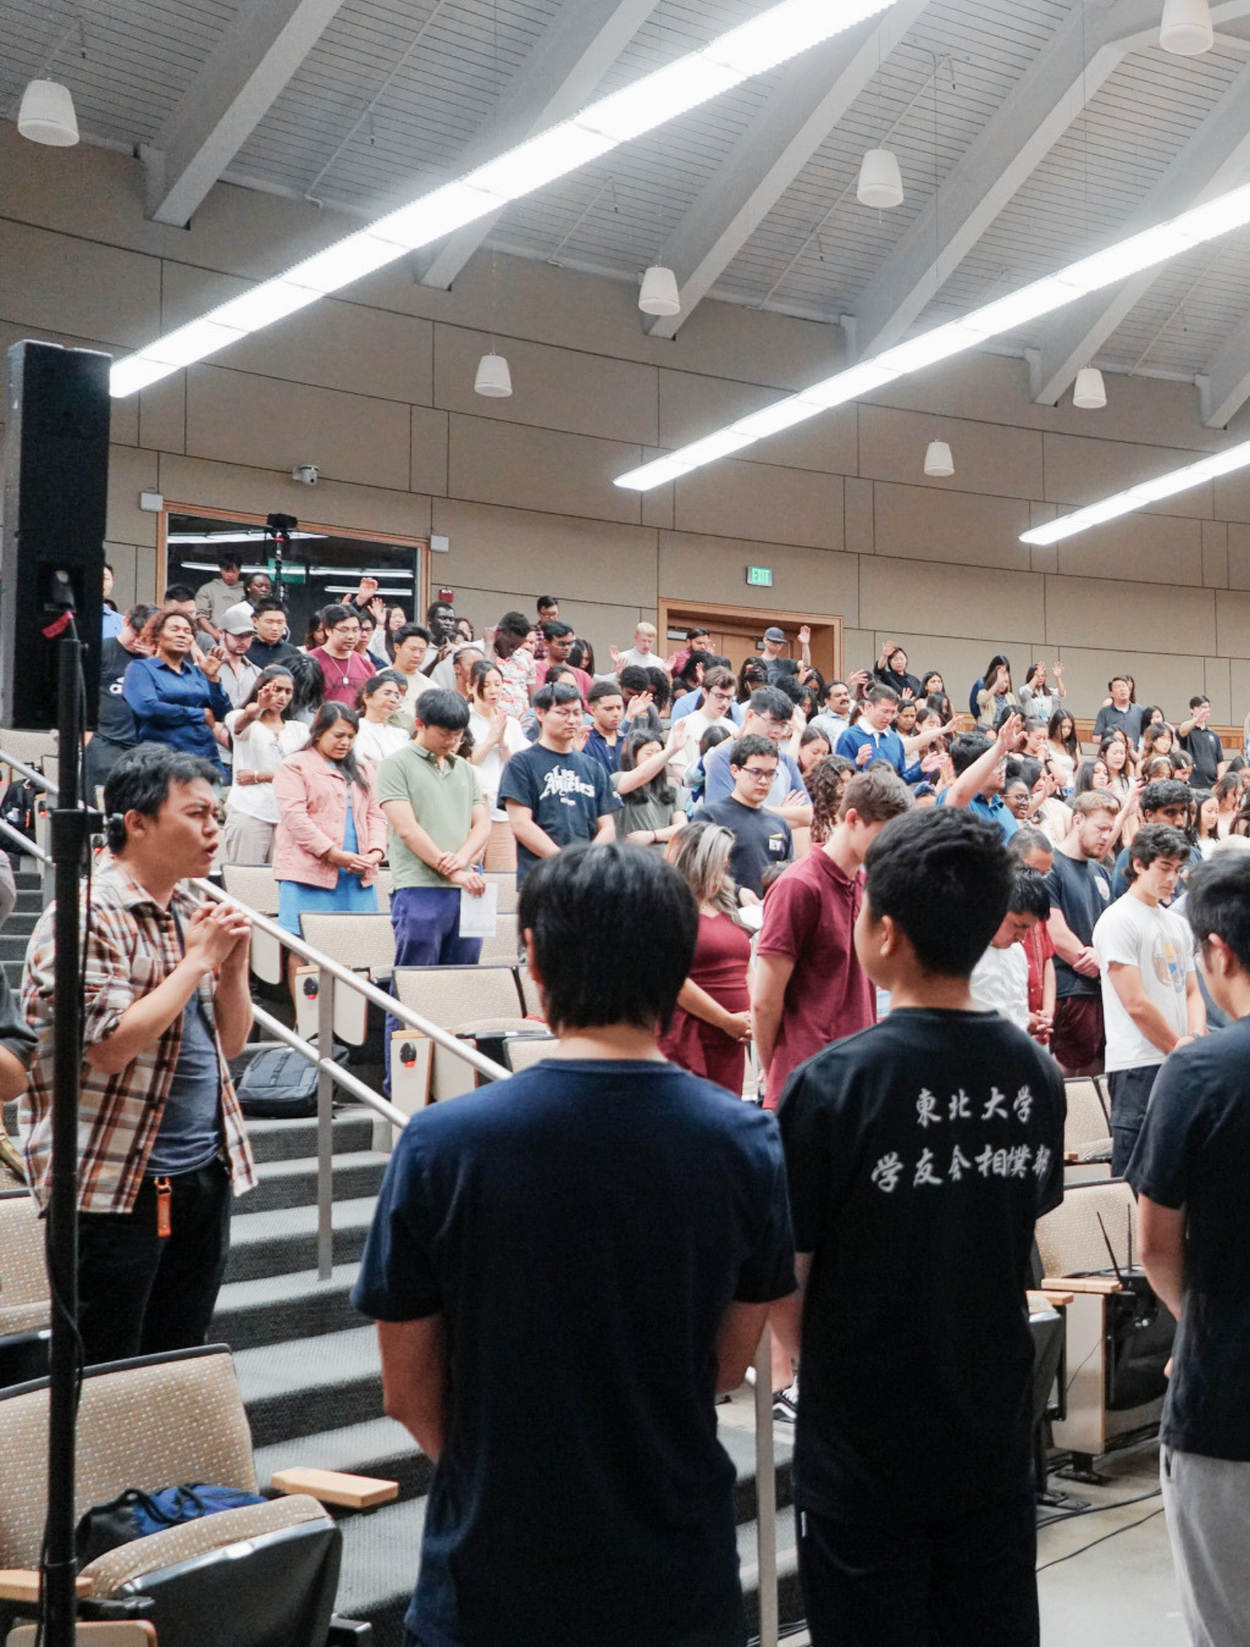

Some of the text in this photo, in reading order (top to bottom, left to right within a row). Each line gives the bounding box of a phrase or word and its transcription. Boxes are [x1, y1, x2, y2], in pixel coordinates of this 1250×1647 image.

[751, 568, 770, 584] EXIT
[539, 772, 595, 800] Angeles
[769, 839, 782, 851] EY
[915, 1084, 1034, 1128] 東北大学
